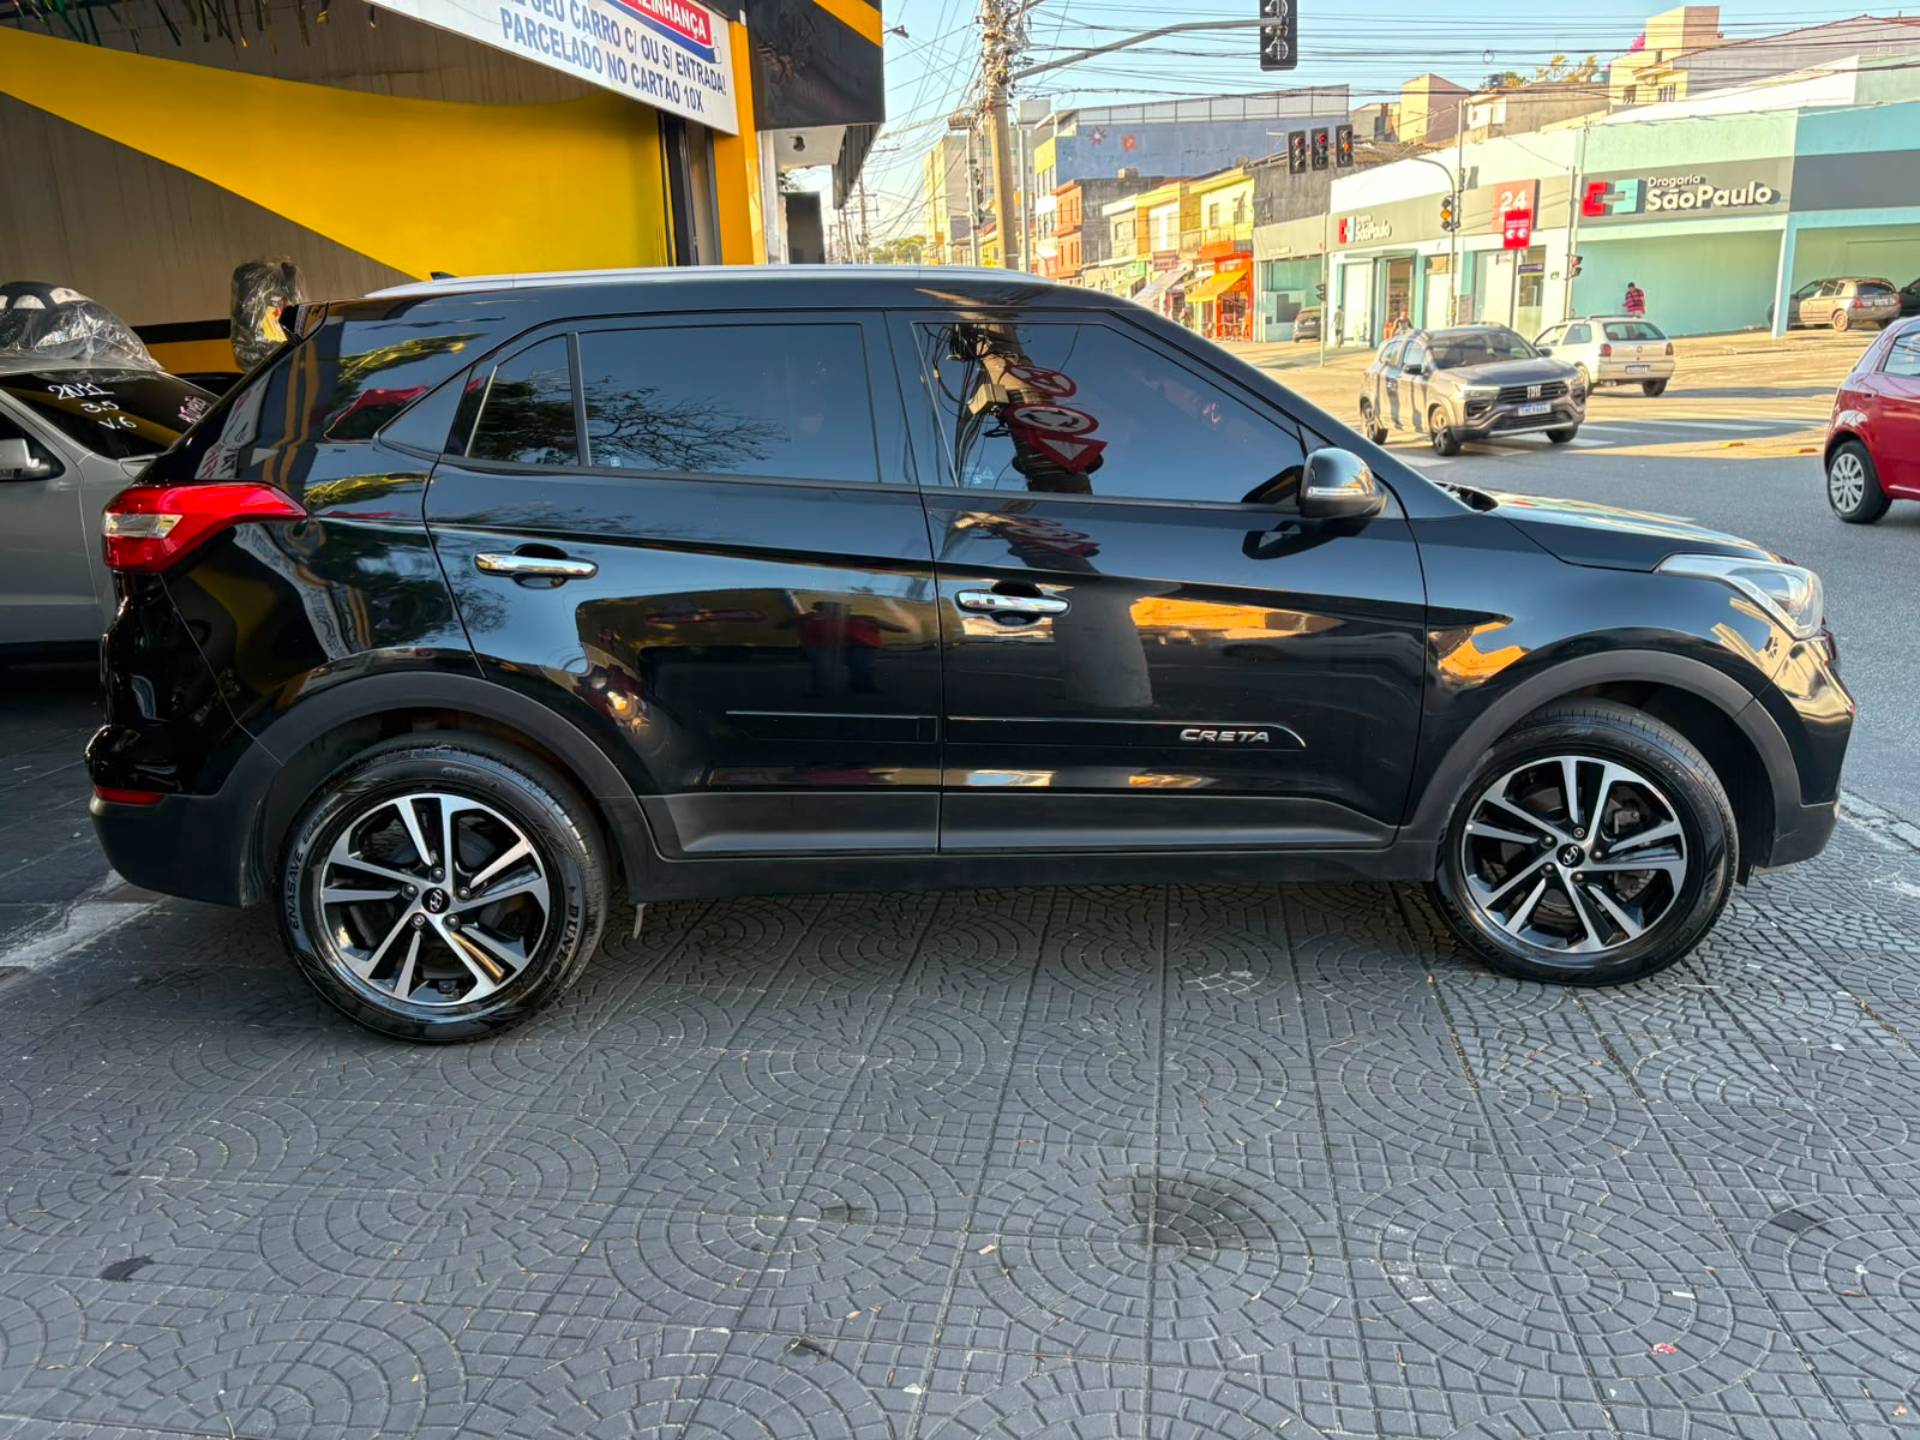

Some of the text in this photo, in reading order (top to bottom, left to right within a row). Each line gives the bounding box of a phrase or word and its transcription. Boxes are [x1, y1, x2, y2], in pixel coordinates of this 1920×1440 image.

[570, 0, 621, 47] CARRO
[641, 34, 659, 64] OU
[675, 52, 727, 96] ENTRADA!
[500, 7, 602, 74] PARCELADO
[606, 53, 628, 84] NO
[683, 85, 704, 112] 10X
[1648, 174, 1700, 188] Drogaria
[1499, 190, 1527, 212] 24
[47, 382, 115, 400] 2011
[80, 400, 120, 413] 3.5
[1180, 728, 1270, 743] CRETA
[286, 848, 304, 930] ENASAVE
